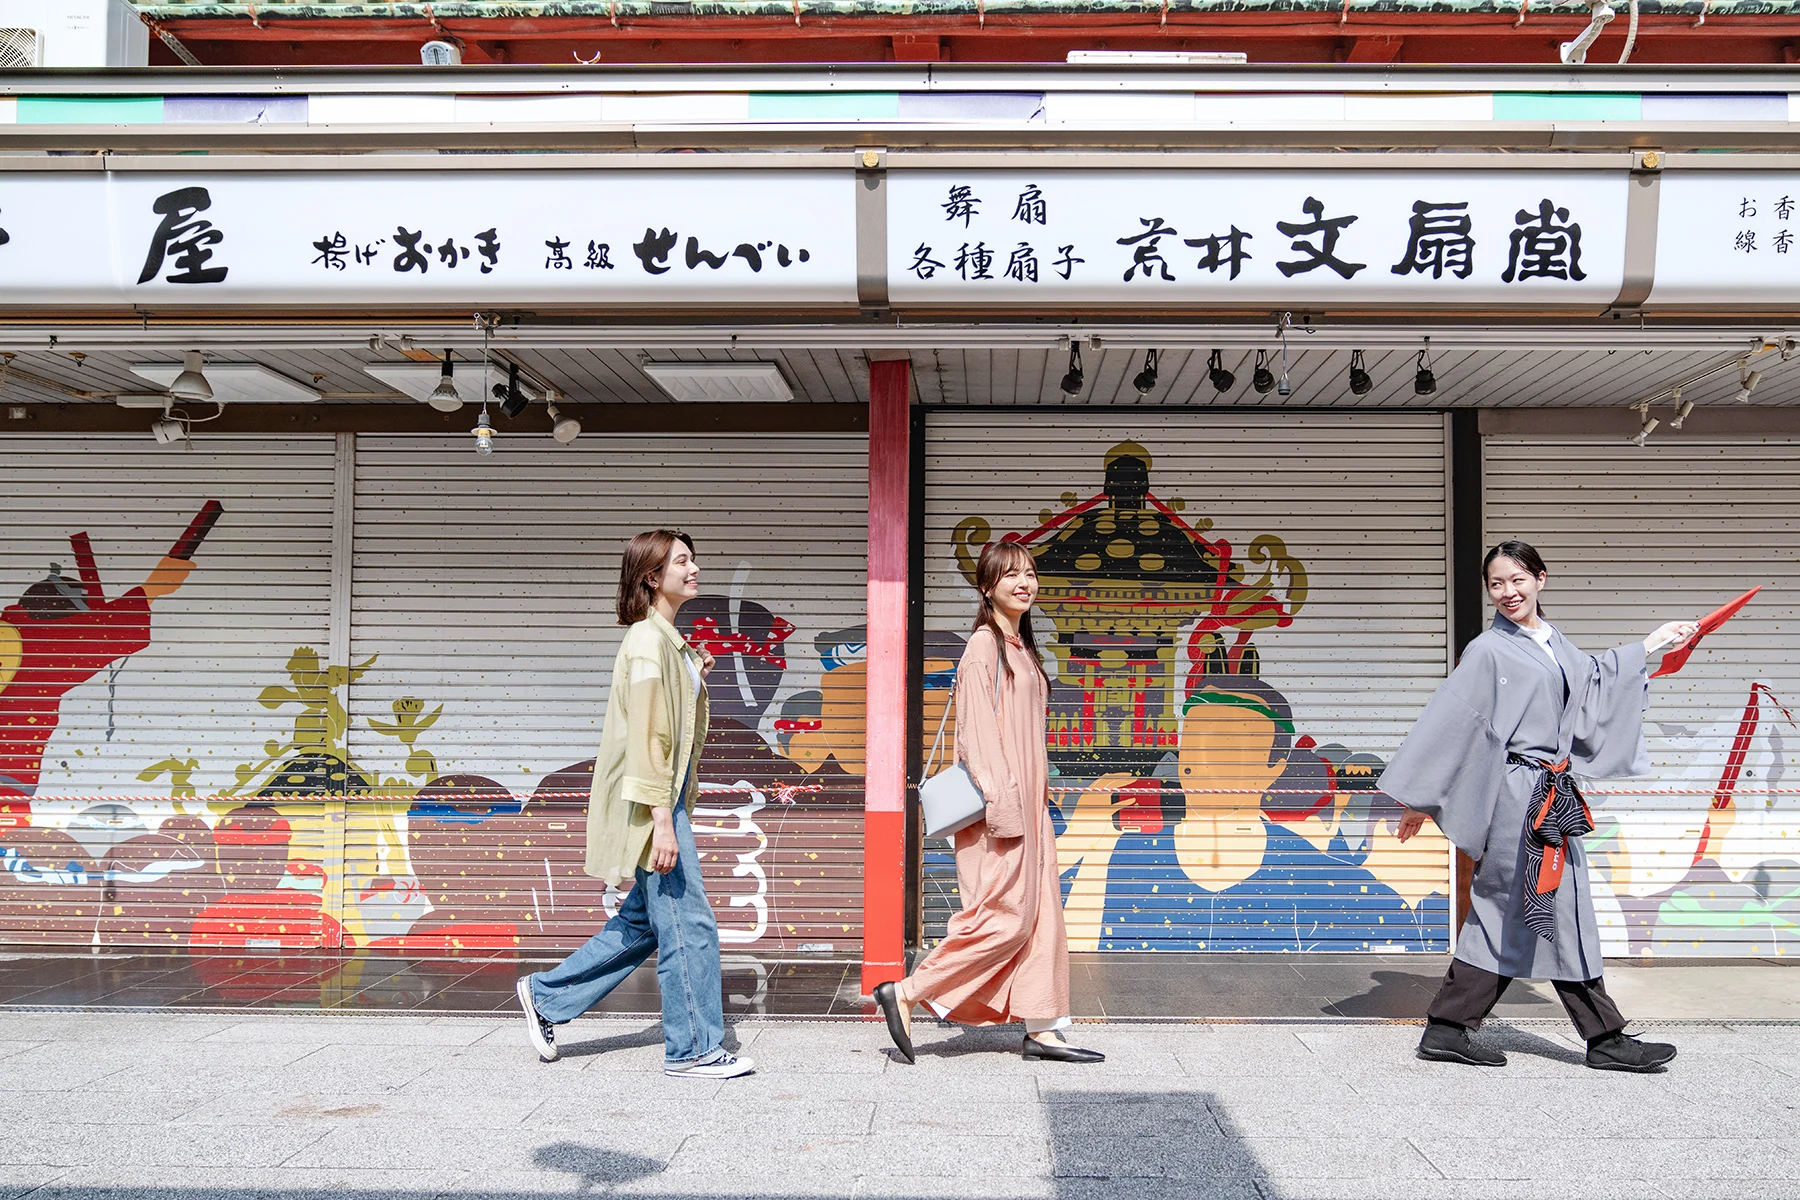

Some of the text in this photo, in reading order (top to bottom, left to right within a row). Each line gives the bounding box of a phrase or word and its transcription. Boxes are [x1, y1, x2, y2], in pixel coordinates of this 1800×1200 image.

[136, 186, 229, 286] 屋
[311, 226, 501, 274] 揚げおかき
[1116, 196, 1588, 284] 荒井文扇堂
[908, 241, 1086, 283] 各種扇子
[1551, 846, 1561, 871] OMO
